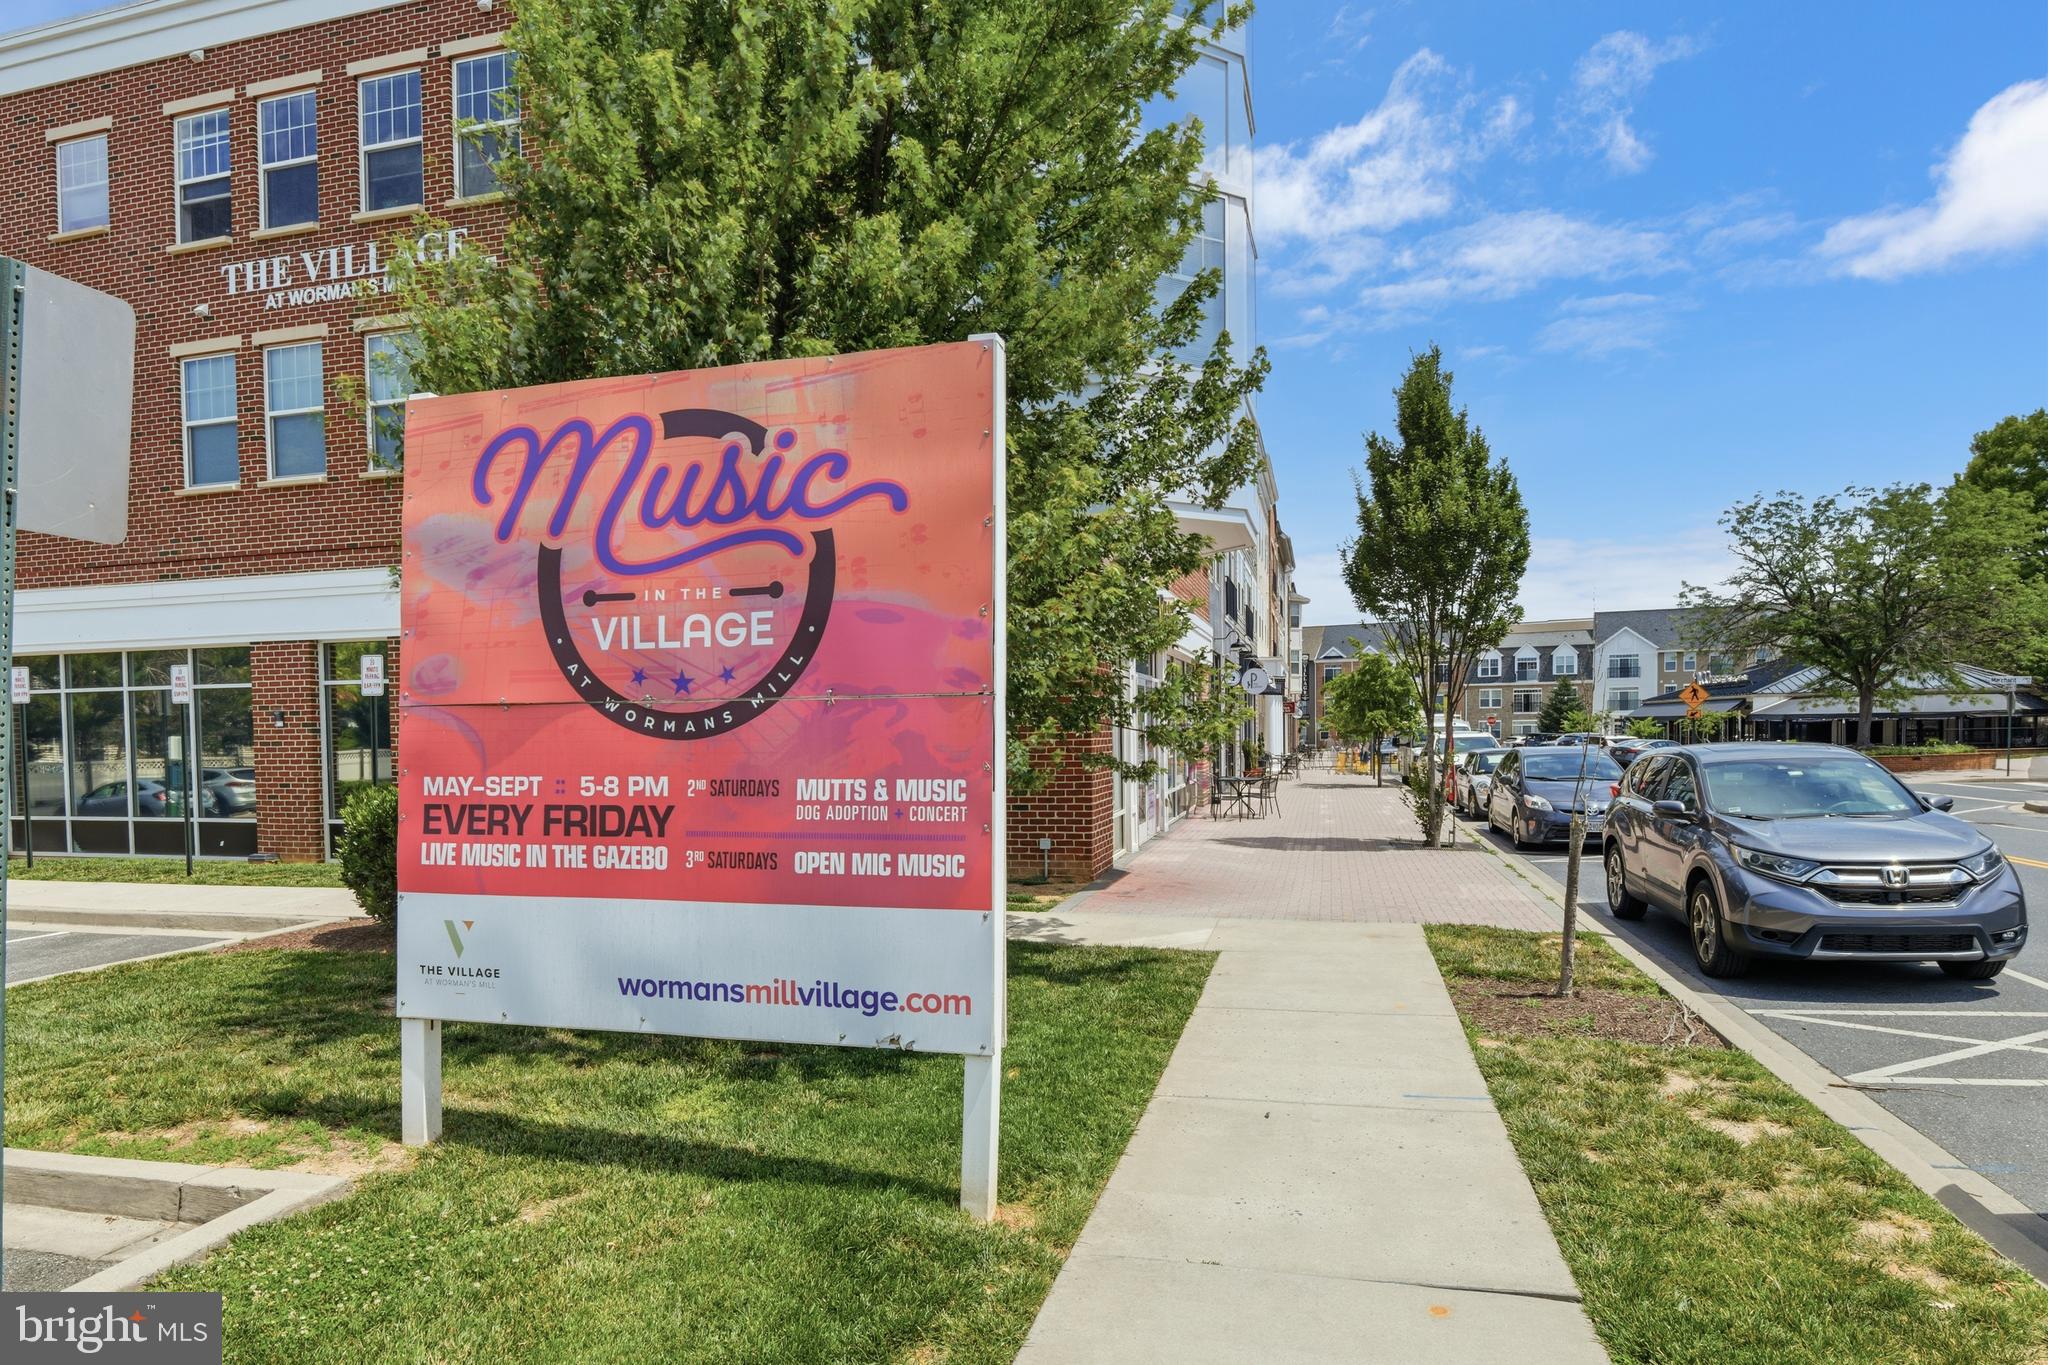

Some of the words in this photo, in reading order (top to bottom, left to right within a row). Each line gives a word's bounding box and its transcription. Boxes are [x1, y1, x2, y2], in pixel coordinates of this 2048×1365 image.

[220, 255, 292, 295] THE
[300, 228, 468, 283] VILLGE
[264, 292, 284, 310] AT
[475, 414, 908, 576] Music
[644, 590, 665, 601] IN
[681, 587, 722, 600] THE
[592, 610, 774, 651] VILLAGE
[568, 663, 591, 688] AT
[605, 696, 733, 732] WORMANS
[751, 655, 803, 709] MILL
[423, 776, 543, 797] MAY-SEPT
[580, 776, 619, 797] 5-8
[628, 776, 668, 797] PM
[710, 779, 780, 798] SATURDAYS
[796, 778, 866, 801] MUTTS
[873, 779, 889, 801] &
[895, 779, 967, 802] MUSIC
[423, 803, 533, 836] EVERY
[543, 804, 675, 838] FRIDAY
[796, 805, 820, 820] DOG
[826, 805, 888, 821] ADOPTION
[909, 806, 968, 822] CONCERT
[421, 842, 456, 865] LIVE
[461, 843, 521, 868] MUSIC
[526, 844, 547, 868] IN
[552, 844, 587, 869] THE
[592, 845, 668, 871] GAZEBO
[707, 851, 778, 870] SATURDAYS
[794, 851, 845, 875] OPEN
[852, 852, 891, 876] MIC
[898, 853, 965, 878] MUSIC
[420, 965, 443, 975] THE
[448, 966, 500, 978] VILLAGE
[618, 977, 972, 1017] wormansmillvillage.com
